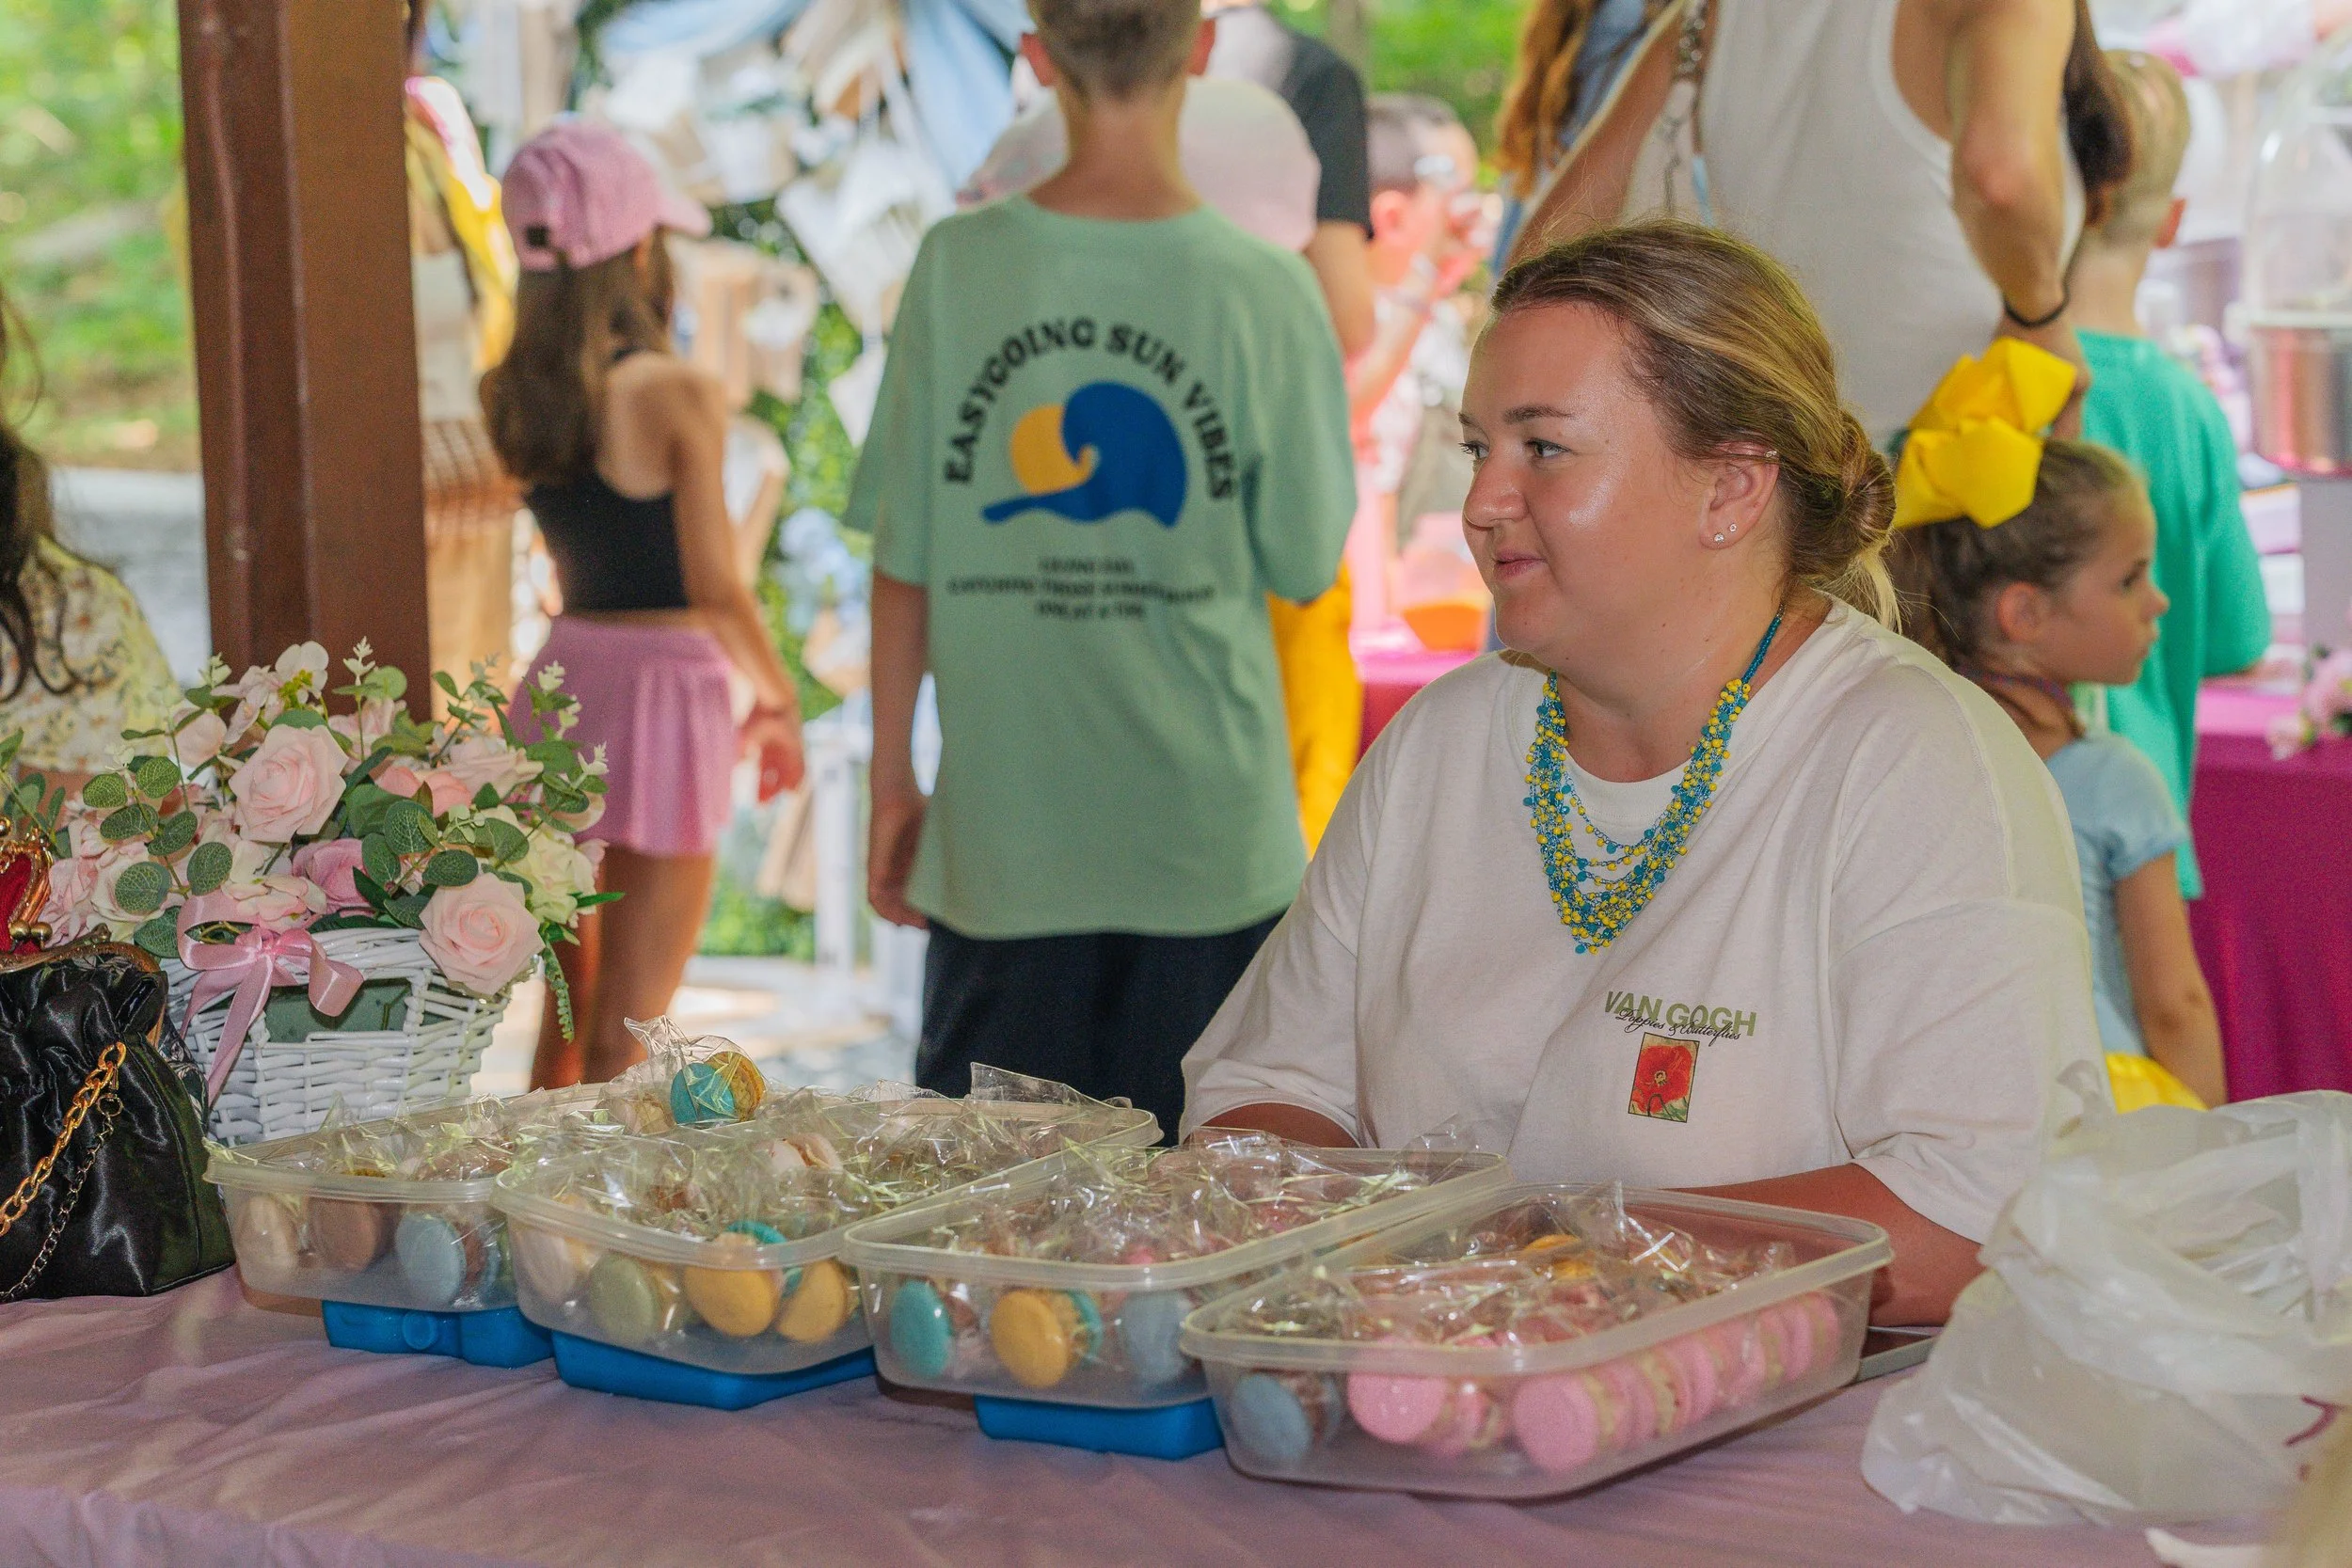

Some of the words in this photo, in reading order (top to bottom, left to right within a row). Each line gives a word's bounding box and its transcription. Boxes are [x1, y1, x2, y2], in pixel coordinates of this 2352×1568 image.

[944, 316, 1097, 485] EASYGOING
[1105, 324, 1186, 387] SUN
[1183, 380, 1236, 501] VIBES
[1604, 990, 1662, 1022] VAN
[1665, 1003, 1757, 1037] GOGH
[1614, 1007, 1666, 1034] Poppies
[1679, 1019, 1741, 1047] Butterflies
